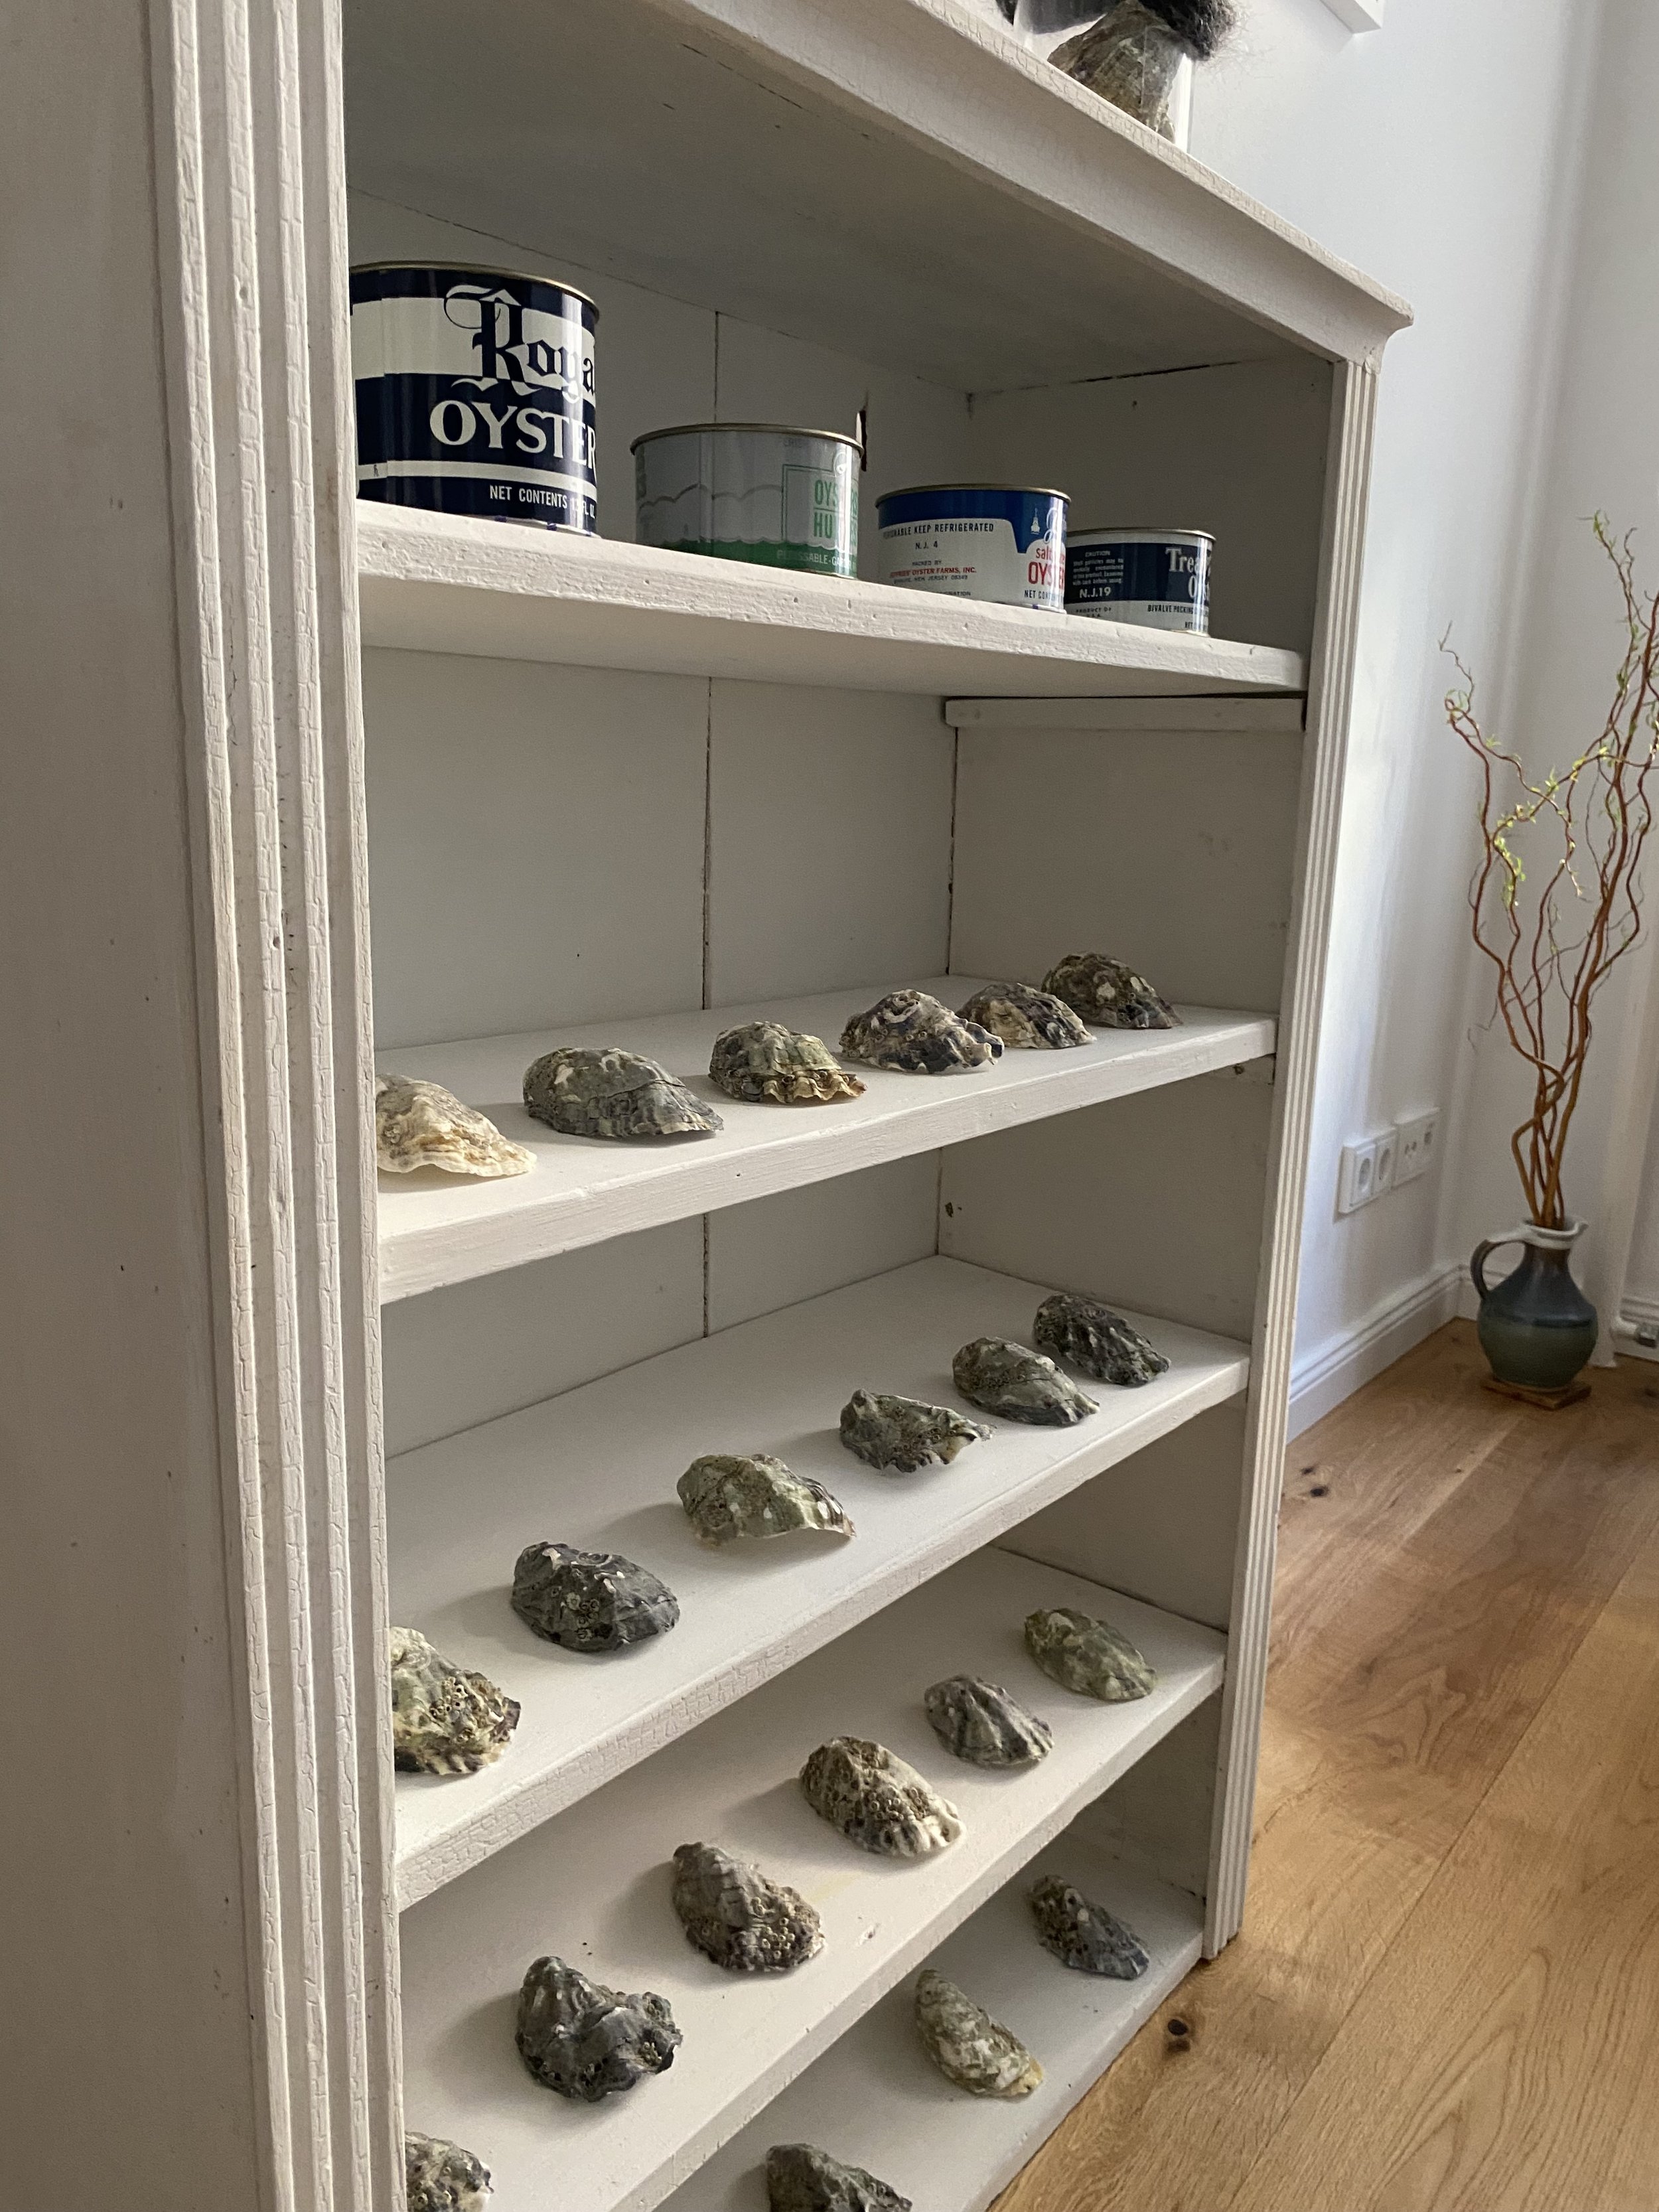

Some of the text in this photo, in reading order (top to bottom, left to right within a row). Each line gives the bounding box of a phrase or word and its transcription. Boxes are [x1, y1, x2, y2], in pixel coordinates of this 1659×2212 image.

[490, 484, 512, 501] NET
[518, 488, 567, 509] CONTENTS
[914, 525, 931, 535] KEEP
[934, 523, 994, 533] REFRIGERATED
[1025, 589, 1036, 599] NET
[1080, 587, 1112, 598] N.J.19
